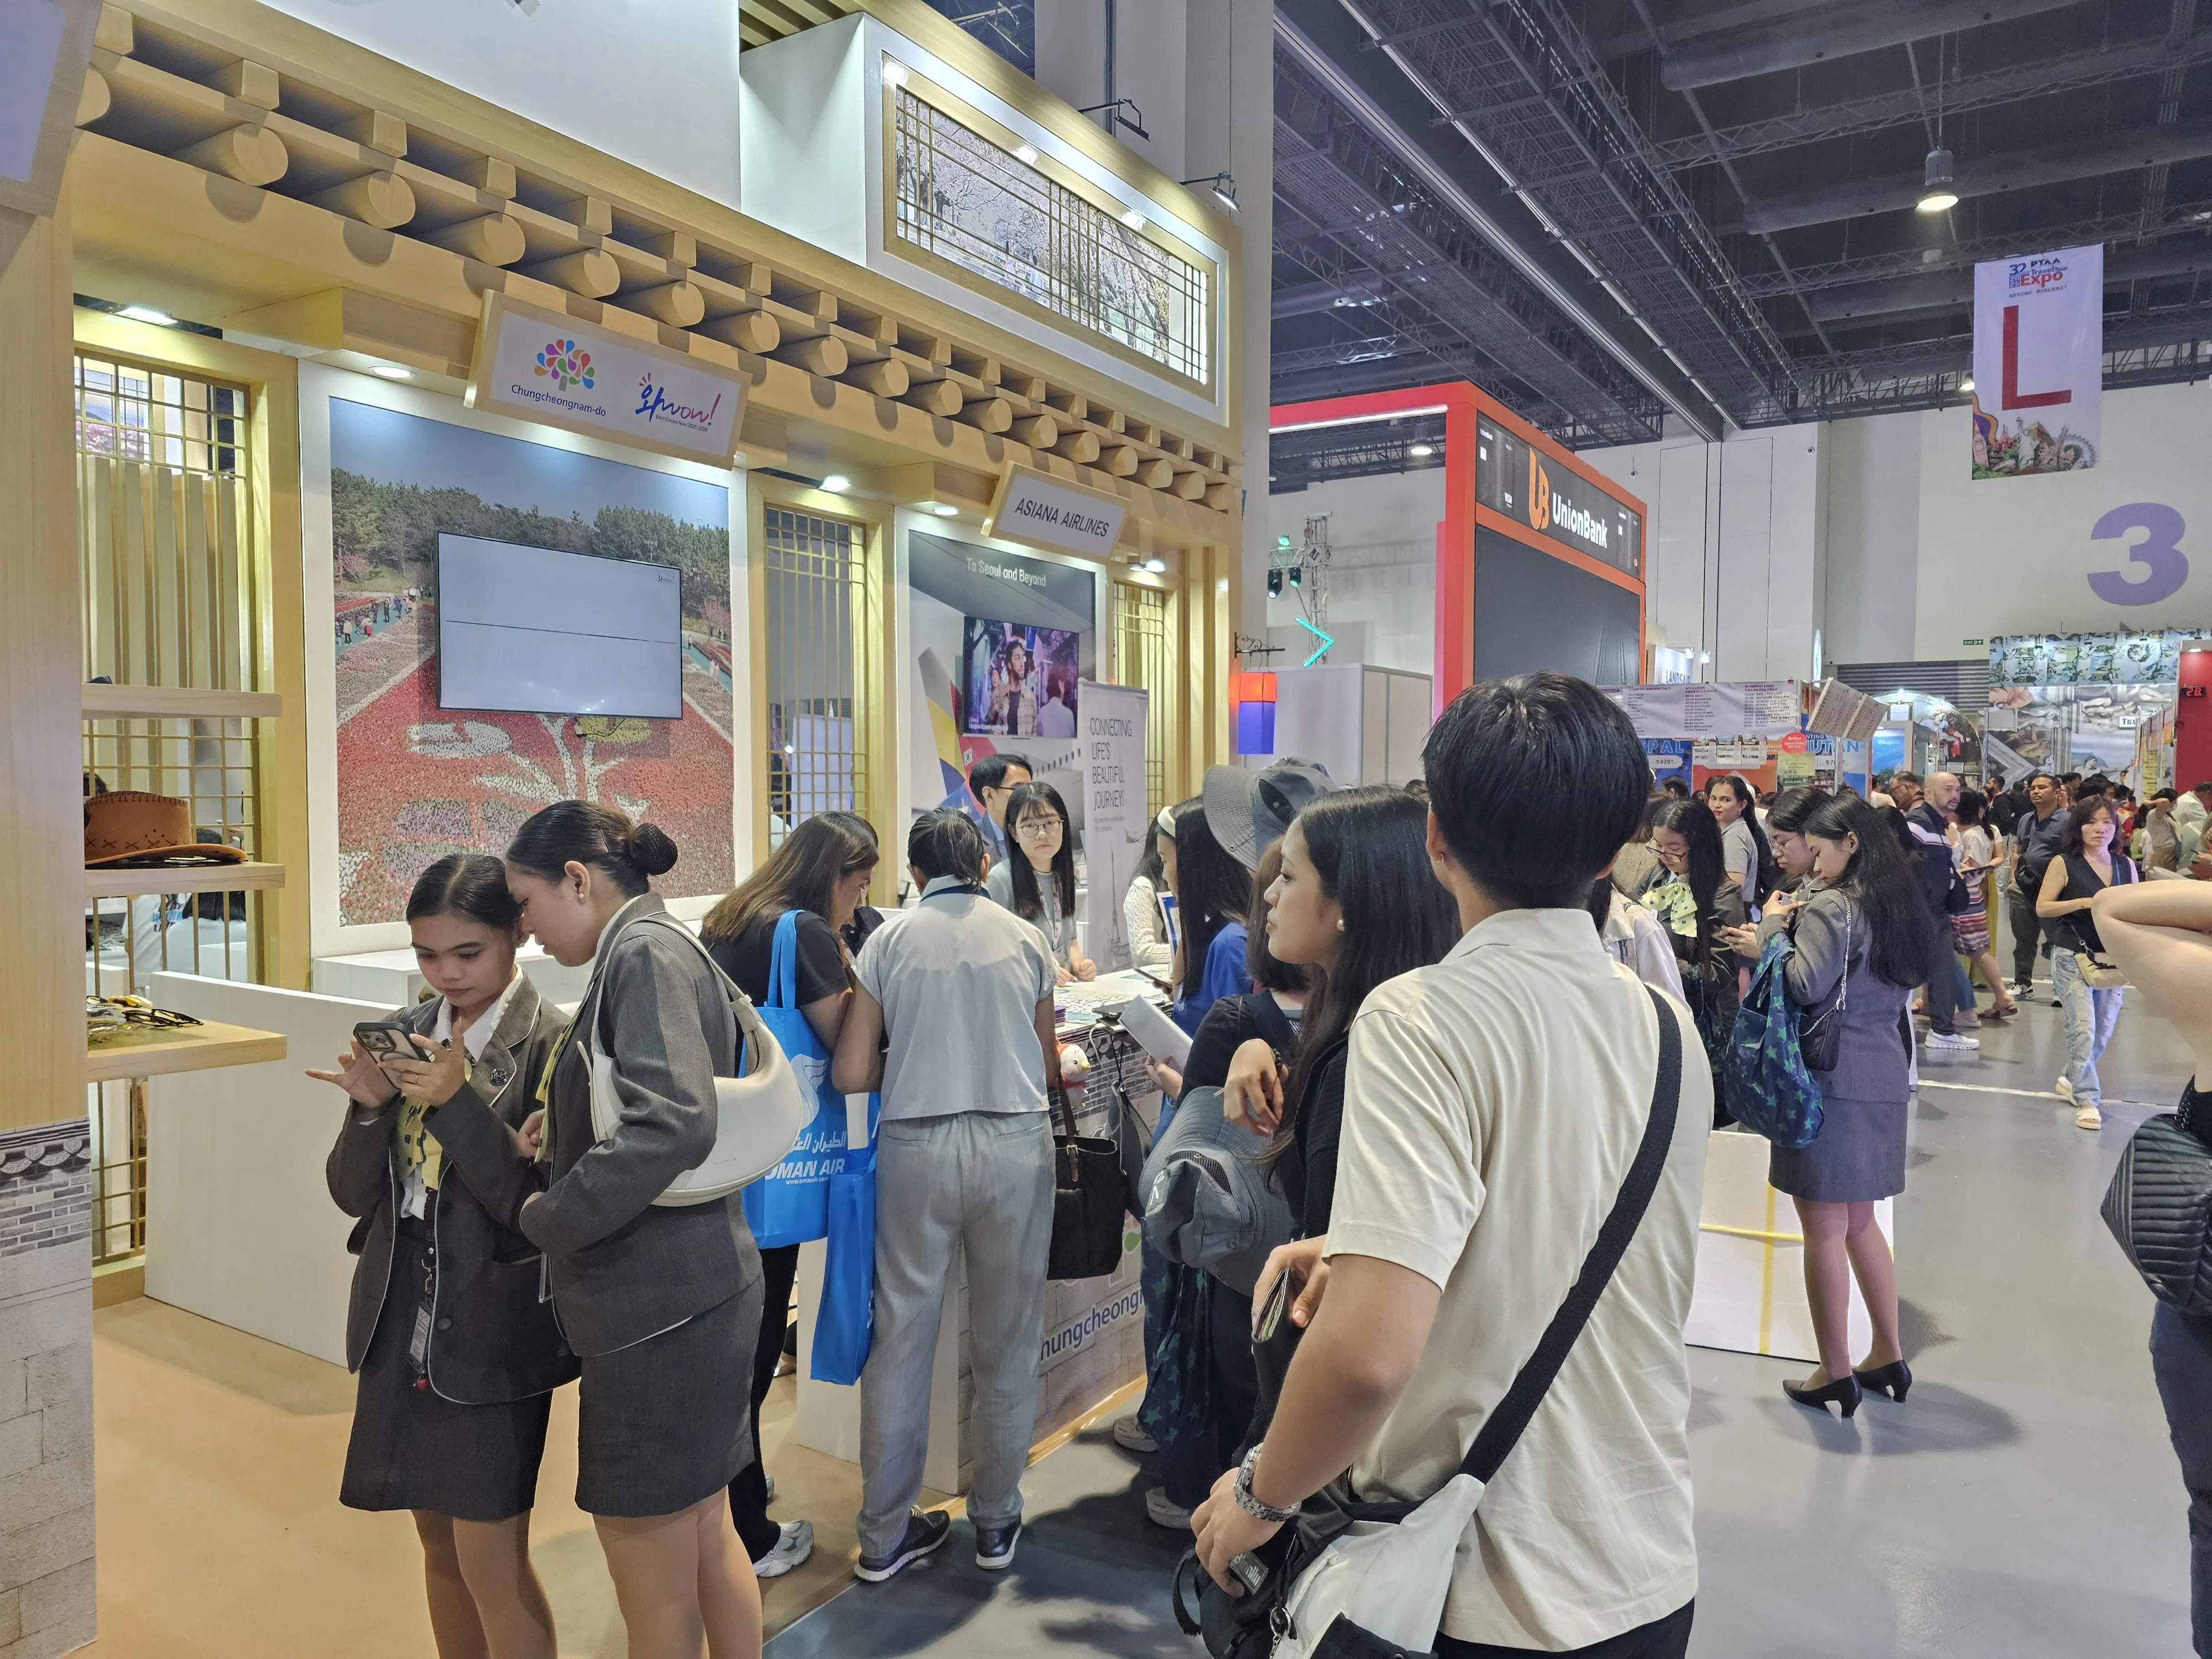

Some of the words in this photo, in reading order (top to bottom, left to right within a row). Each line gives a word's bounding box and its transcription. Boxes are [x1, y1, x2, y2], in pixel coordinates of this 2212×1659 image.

[2031, 257, 2062, 268] PTAA
[2021, 272, 2063, 288] Expo
[2002, 305, 2072, 411] L
[511, 384, 607, 417] Chungcheongnam-do
[1014, 498, 1059, 525] ASIANA
[1060, 511, 1110, 538] AIRLINES
[1552, 491, 1608, 550] UnionBank
[2086, 502, 2189, 606] 3
[966, 557, 977, 572] To
[978, 560, 1001, 577] Seoul
[1003, 567, 1018, 581] and
[1019, 568, 1046, 587] Beyond
[1090, 717, 1132, 737] CONNECTING
[1092, 742, 1110, 760] LIFE'S
[1092, 765, 1125, 784] BEAUTIFUL
[1093, 789, 1125, 811] JOURNEYS
[818, 1158, 846, 1176] AIR
[1040, 1286, 1143, 1361] hungcheong
